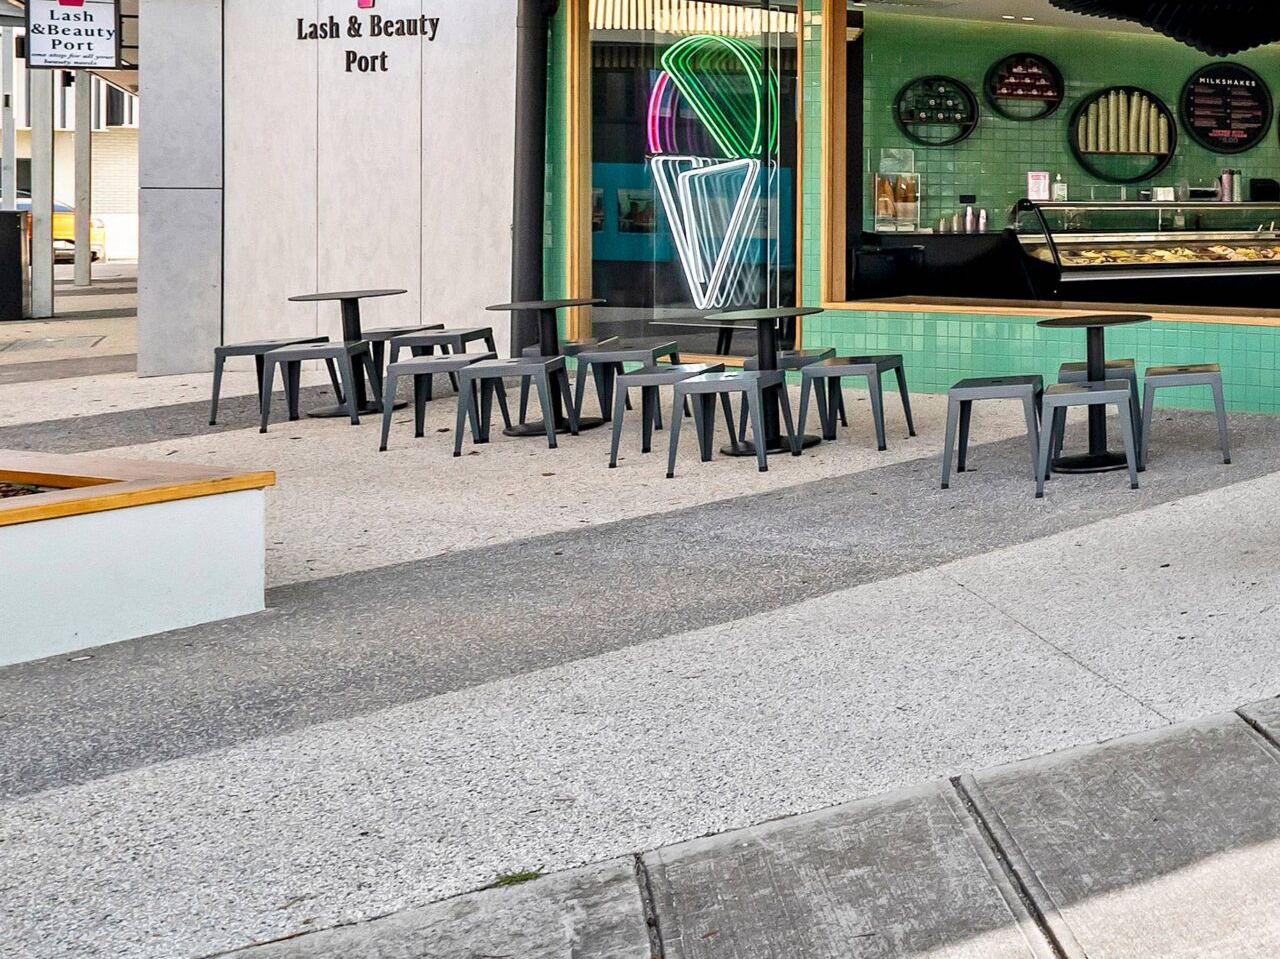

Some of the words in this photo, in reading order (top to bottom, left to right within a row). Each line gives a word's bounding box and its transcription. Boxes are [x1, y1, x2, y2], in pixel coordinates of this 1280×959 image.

[49, 9, 94, 22] Lash
[297, 16, 340, 40] Lash
[347, 15, 363, 38] &
[369, 14, 440, 41] Beauty
[51, 39, 94, 51] Port
[345, 50, 389, 72] Port
[1199, 77, 1256, 87] MILKSHAKES
